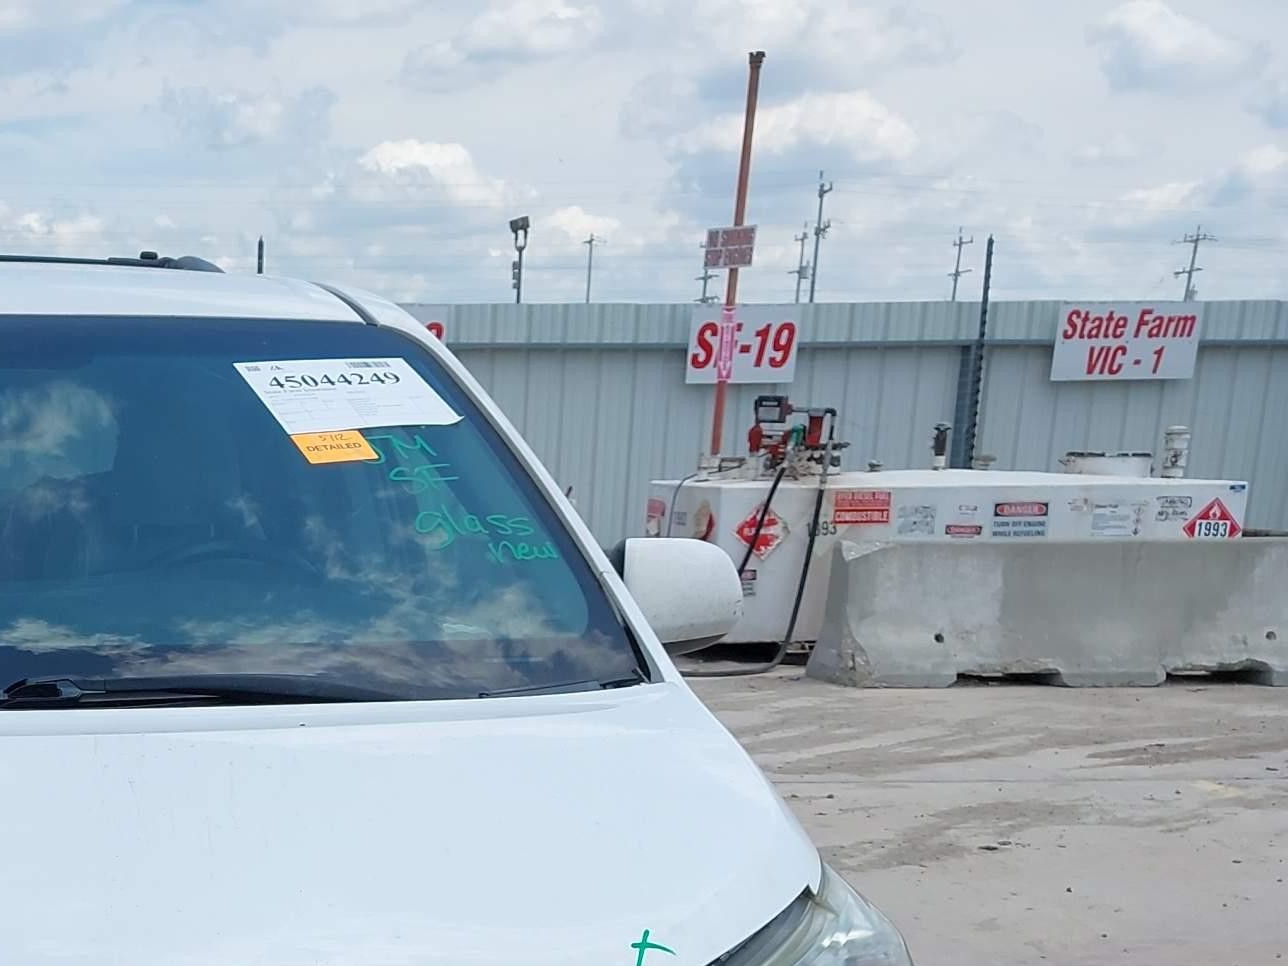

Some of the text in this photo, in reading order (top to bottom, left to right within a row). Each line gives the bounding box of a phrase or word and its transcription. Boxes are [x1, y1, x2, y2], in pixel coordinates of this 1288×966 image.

[1062, 308, 1197, 340] State Farm
[690, 321, 797, 369] S-19
[1086, 344, 1128, 375] VIC
[1152, 345, 1165, 375] 1
[268, 371, 401, 389] 45044249
[306, 442, 362, 452] DETAILED
[1197, 521, 1228, 537] 1993
